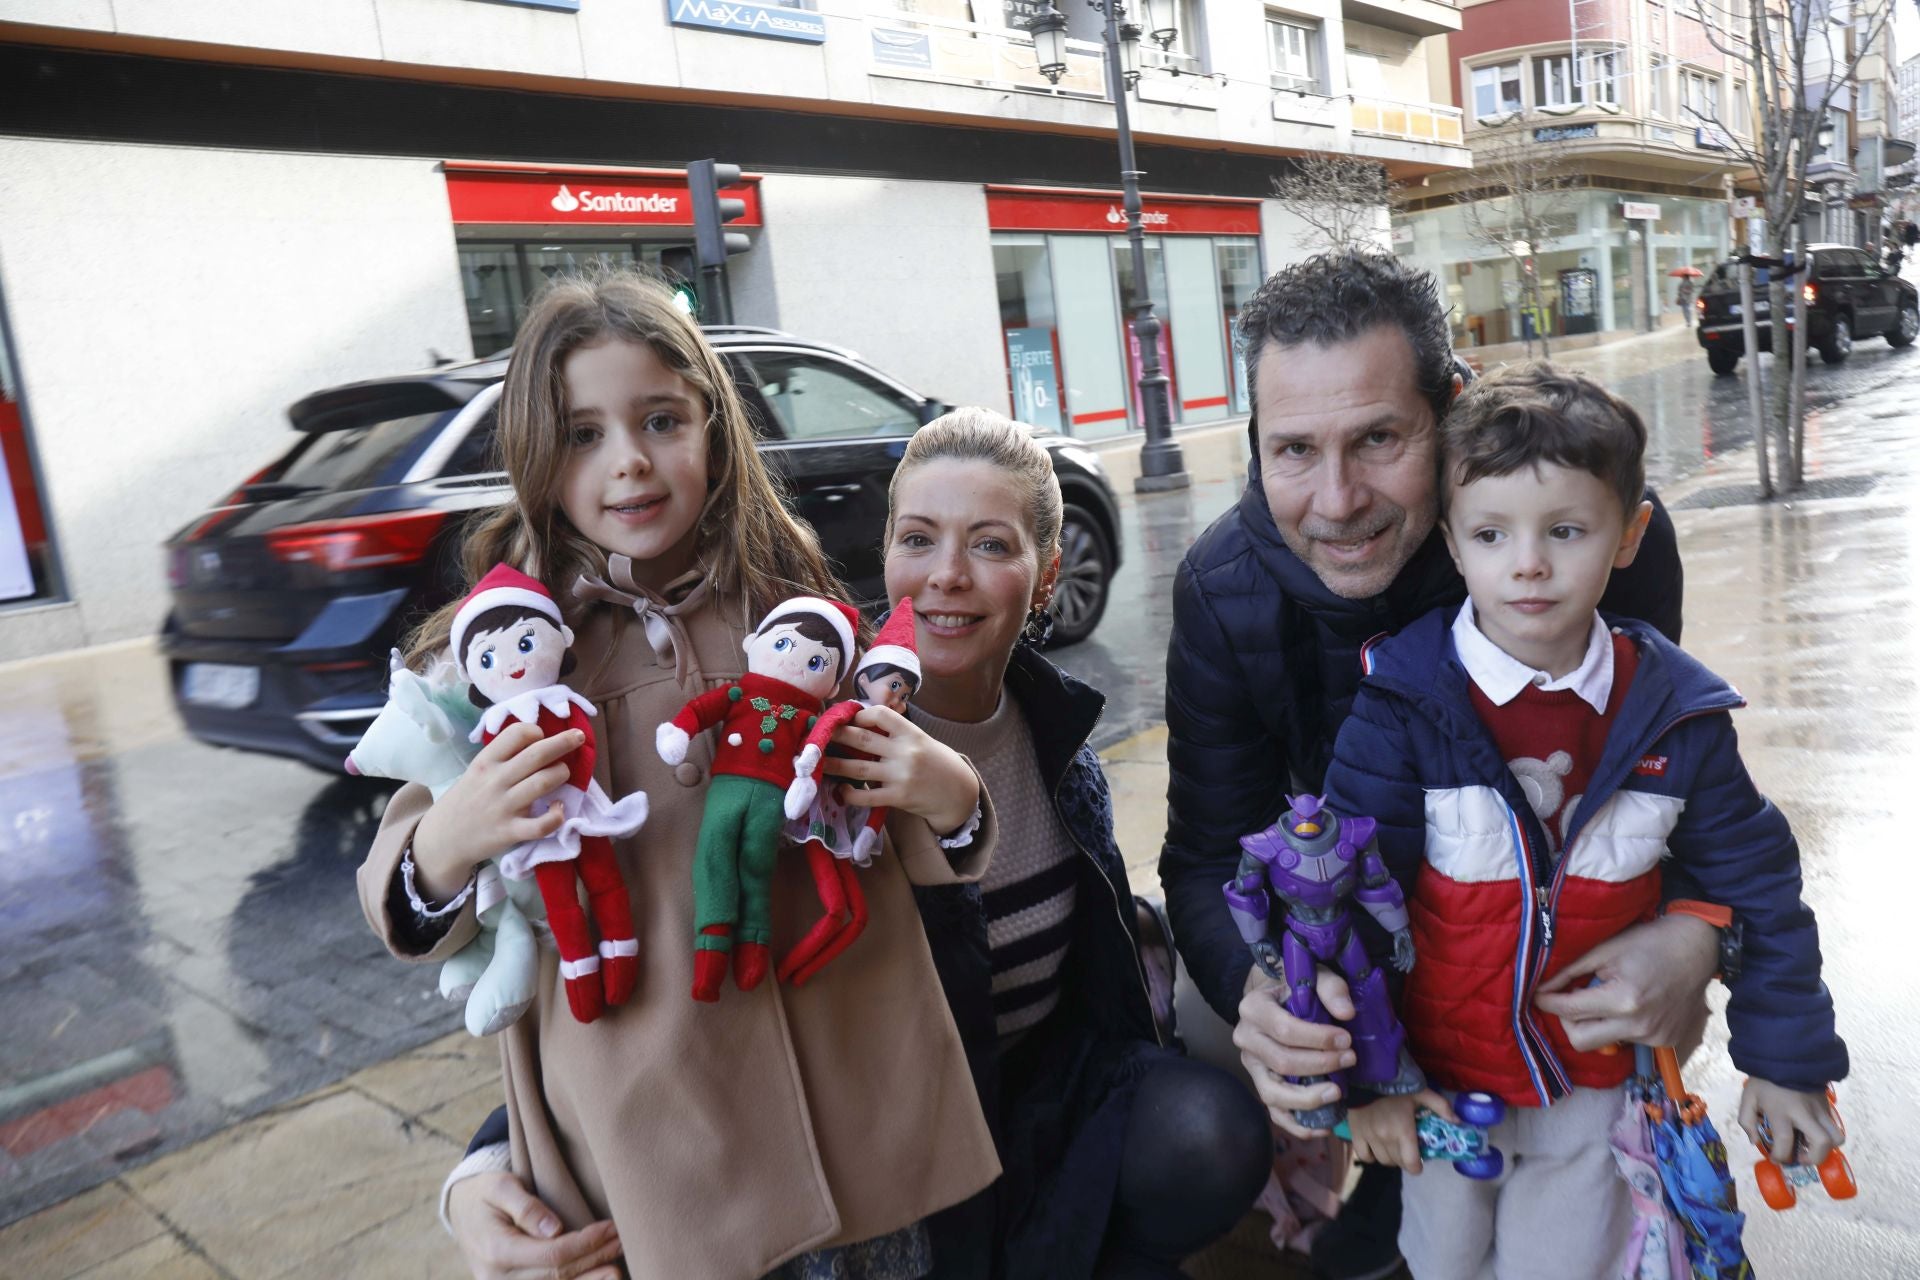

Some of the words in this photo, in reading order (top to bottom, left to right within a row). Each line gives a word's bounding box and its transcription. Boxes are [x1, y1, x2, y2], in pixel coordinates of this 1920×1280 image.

[579, 191, 678, 213] Santander
[1120, 209, 1168, 224] Sander
[1010, 350, 1053, 368] FUERTE
